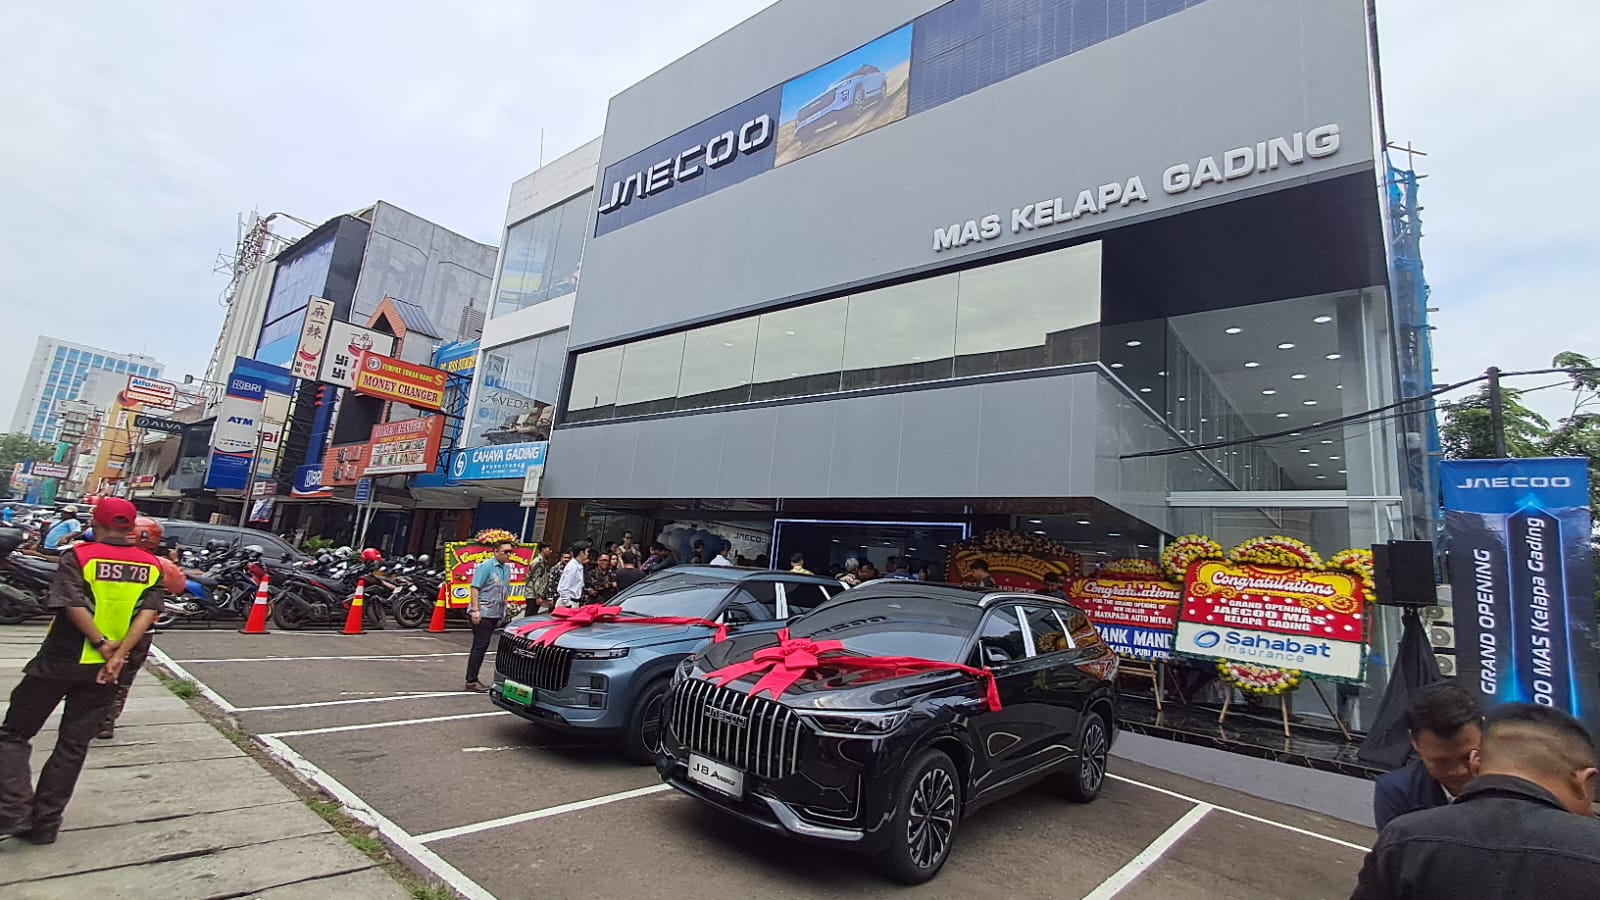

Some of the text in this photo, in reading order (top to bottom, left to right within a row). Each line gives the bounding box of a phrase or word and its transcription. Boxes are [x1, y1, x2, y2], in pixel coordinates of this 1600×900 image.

[597, 113, 774, 214] JAECOO
[932, 123, 1341, 251] MAS KELAPA GADING
[131, 378, 172, 392] Alfamart
[244, 381, 262, 393] BRI
[363, 374, 439, 402] MONEY CHANGER
[227, 416, 254, 427] ATM
[472, 447, 540, 463] CAHAYA GADING
[1457, 477, 1572, 489] JAECOO
[1525, 516, 1545, 572] Gading
[98, 563, 148, 582] BS 78
[1212, 571, 1336, 595] Congratulations
[1124, 607, 1145, 615] DEALER
[1229, 599, 1310, 615] GRAND OPENING
[1530, 575, 1551, 632] Kelapa
[1094, 610, 1130, 621] MAYAPADA
[1131, 613, 1149, 622] AUTO
[1149, 615, 1173, 625] MITRA
[1212, 605, 1327, 626] JAECOO MAS
[1224, 614, 1311, 632] KELAPA GADING
[1473, 548, 1496, 695] GRAND OPENING
[1134, 647, 1151, 657] PURI
[1224, 630, 1331, 658] Sahabat
[1223, 645, 1305, 663] insurance
[1532, 635, 1552, 677] MAS
